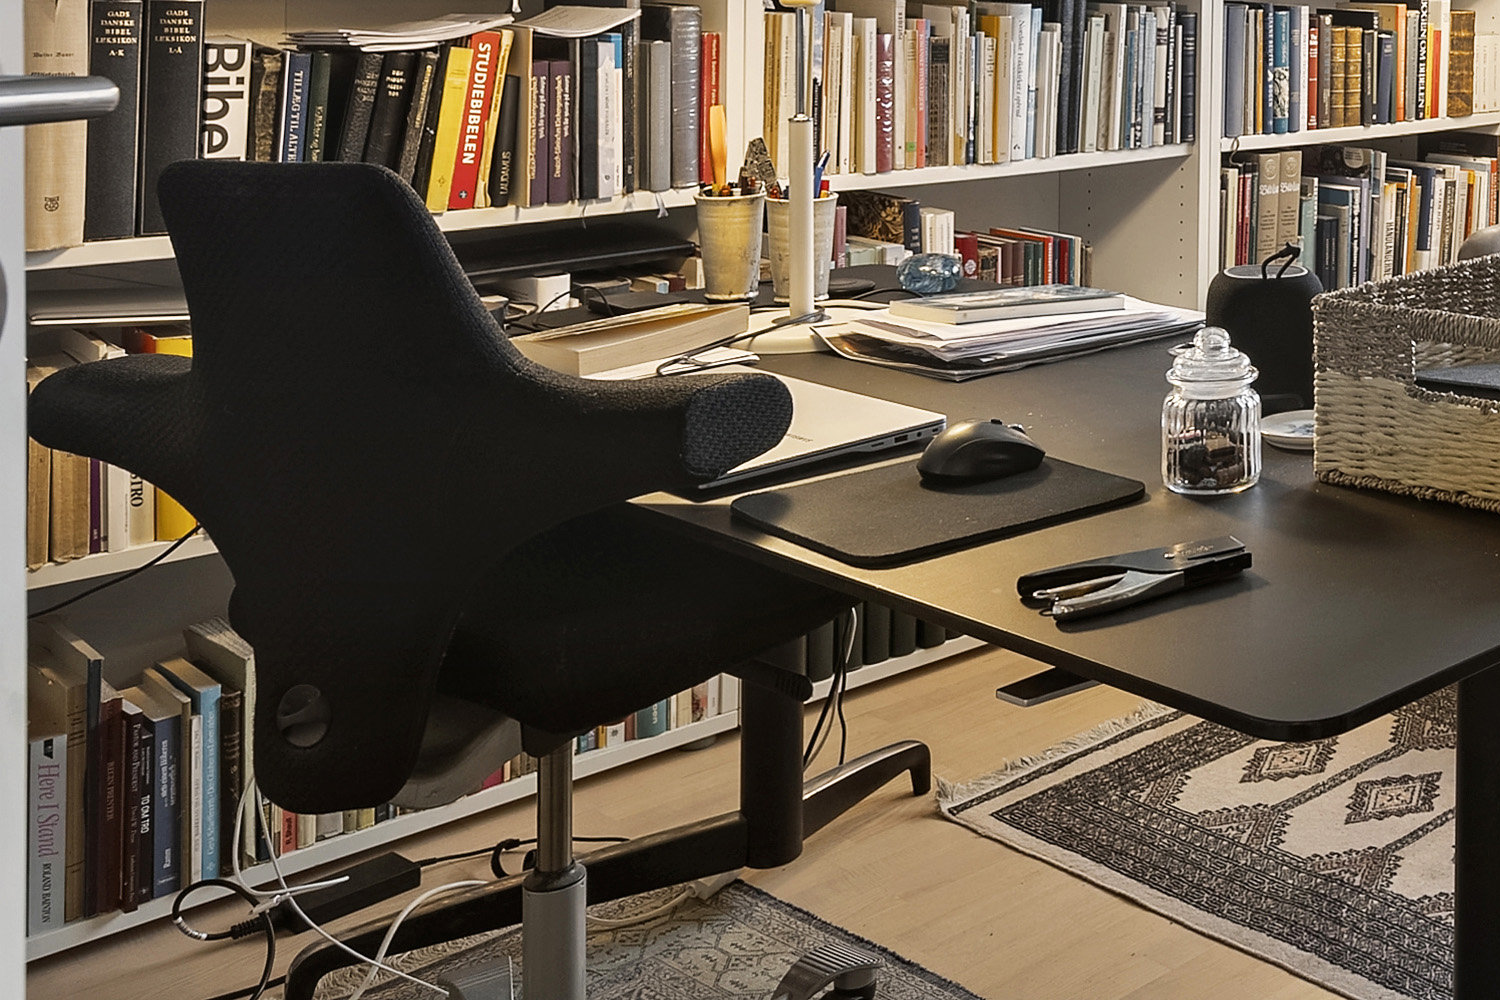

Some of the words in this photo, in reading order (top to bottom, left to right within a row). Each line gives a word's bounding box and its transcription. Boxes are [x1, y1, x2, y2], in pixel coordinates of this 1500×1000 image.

[107, 10, 130, 18] GADS
[1419, 40, 1426, 61] OM
[292, 70, 303, 112] TILLÆG
[1418, 63, 1426, 108] BIBELEN
[462, 42, 491, 164] STUDIEBIBELEN
[290, 114, 300, 132] TIL
[37, 764, 59, 799] Here
[140, 795, 150, 805] TO
[140, 807, 149, 819] OM
[37, 814, 59, 858] Stand
[140, 819, 150, 834] TRO
[42, 862, 52, 891] ROLAND
[41, 893, 51, 923] BAINTON
